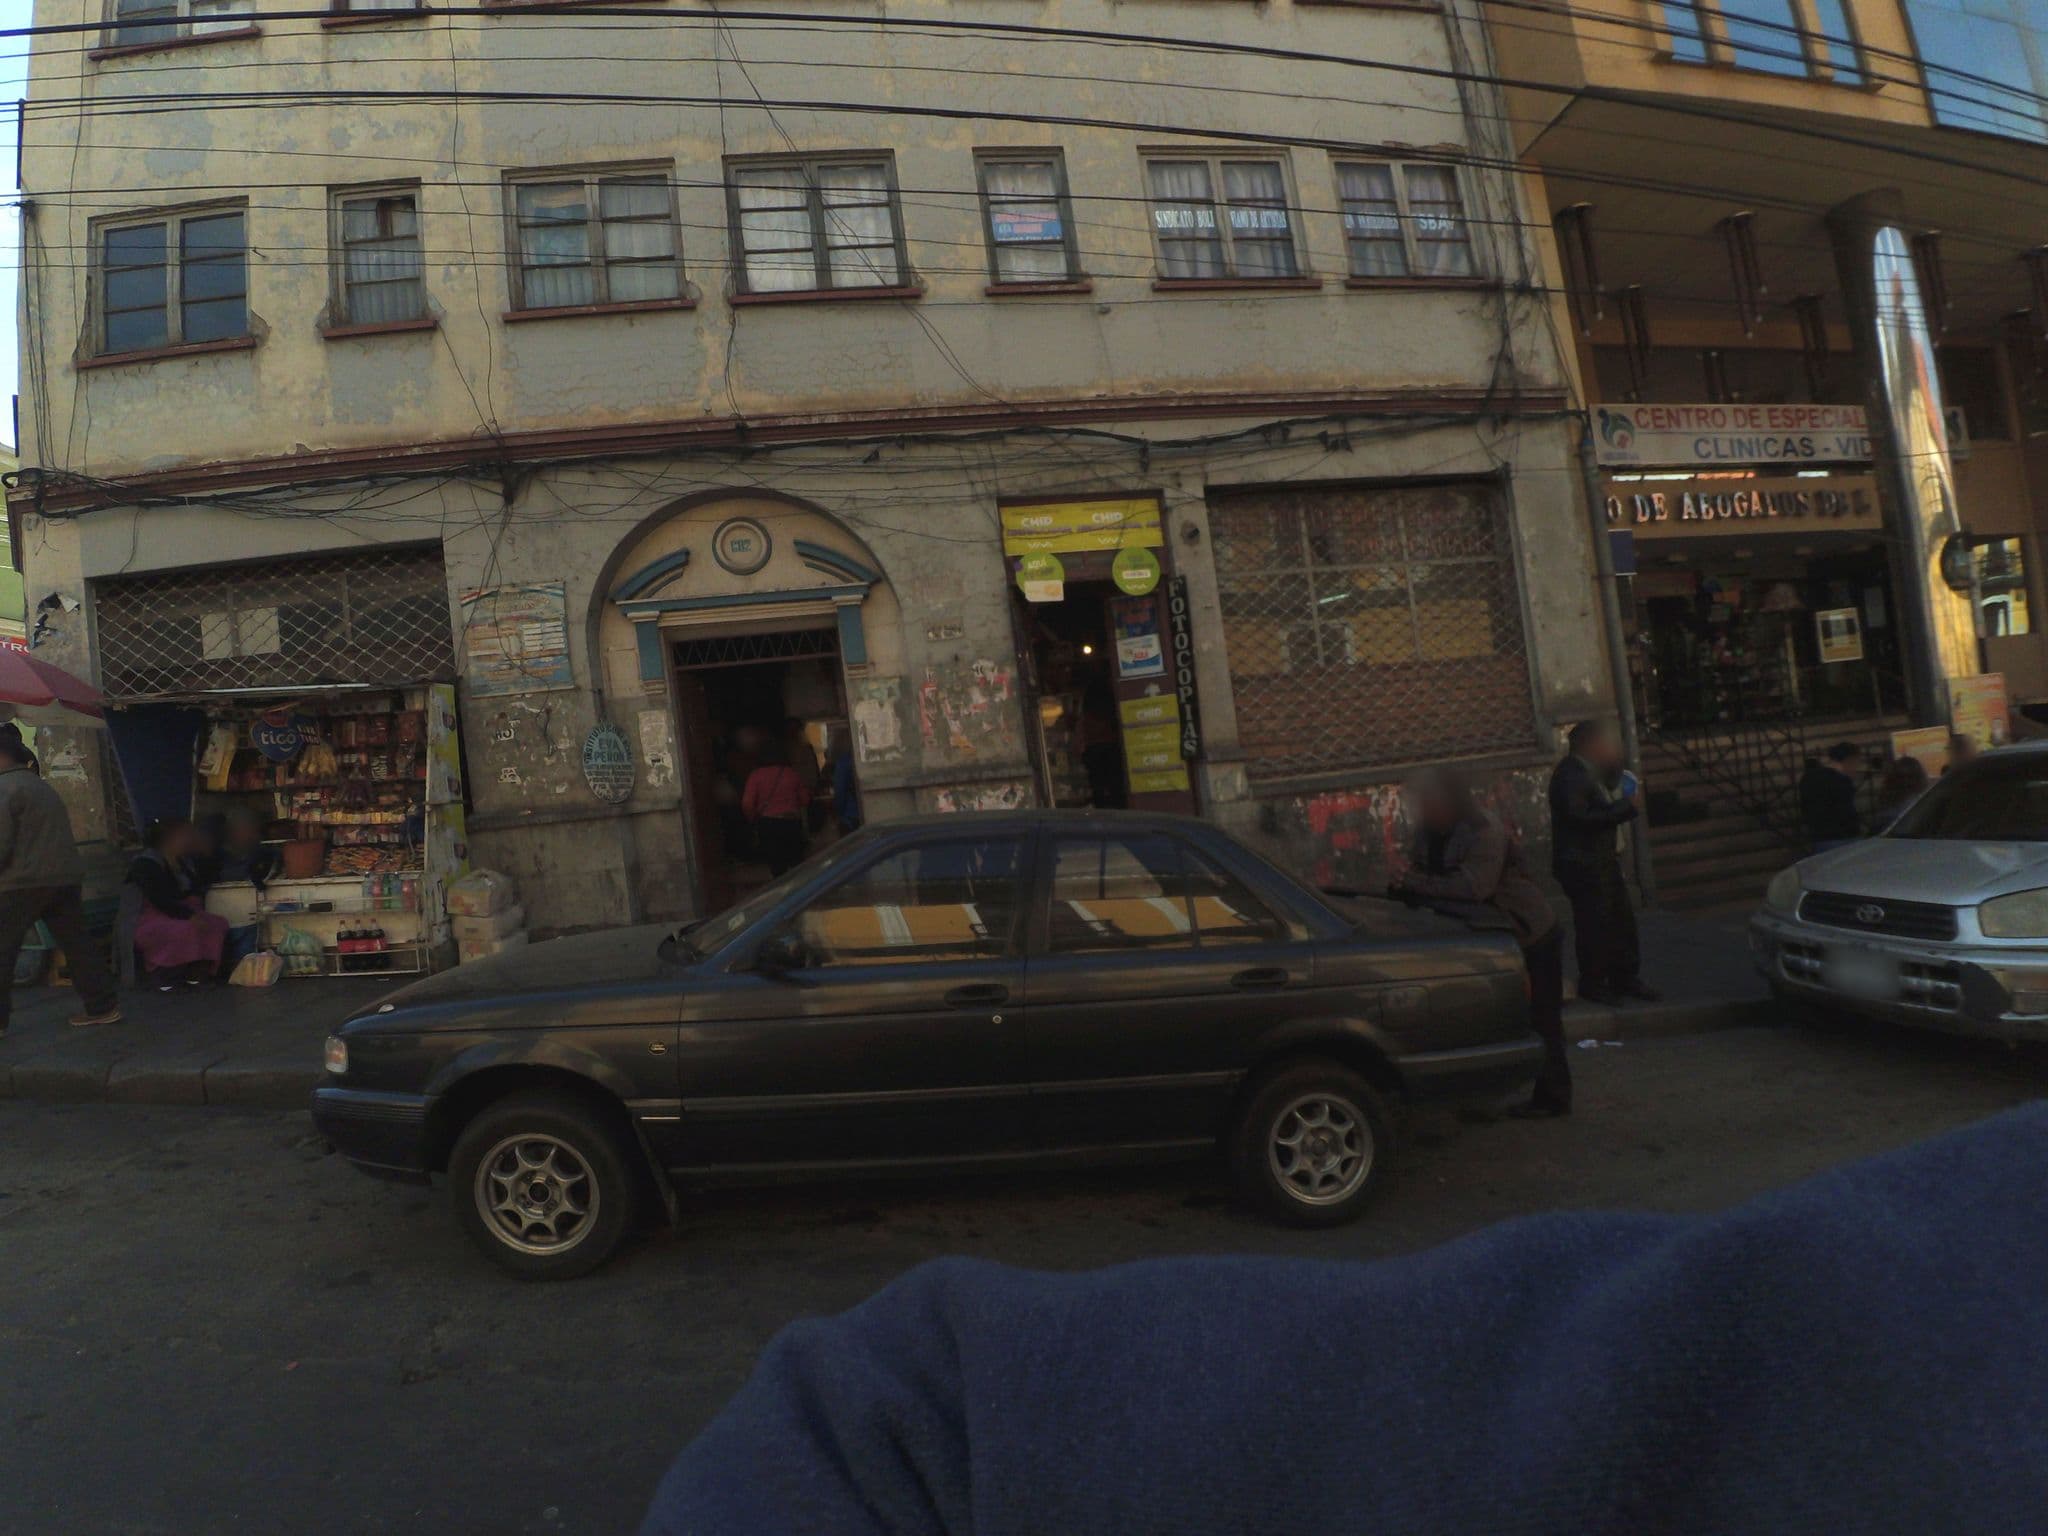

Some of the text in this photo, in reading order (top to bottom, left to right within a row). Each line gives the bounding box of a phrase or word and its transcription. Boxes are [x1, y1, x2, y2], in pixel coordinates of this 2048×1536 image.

[1634, 407, 1727, 429] CENTRO
[1733, 408, 1762, 428] DE
[1694, 437, 1816, 460] CLINICAS
[1634, 493, 1669, 523] DE
[1169, 578, 1198, 754] FOTOCOPIAS
